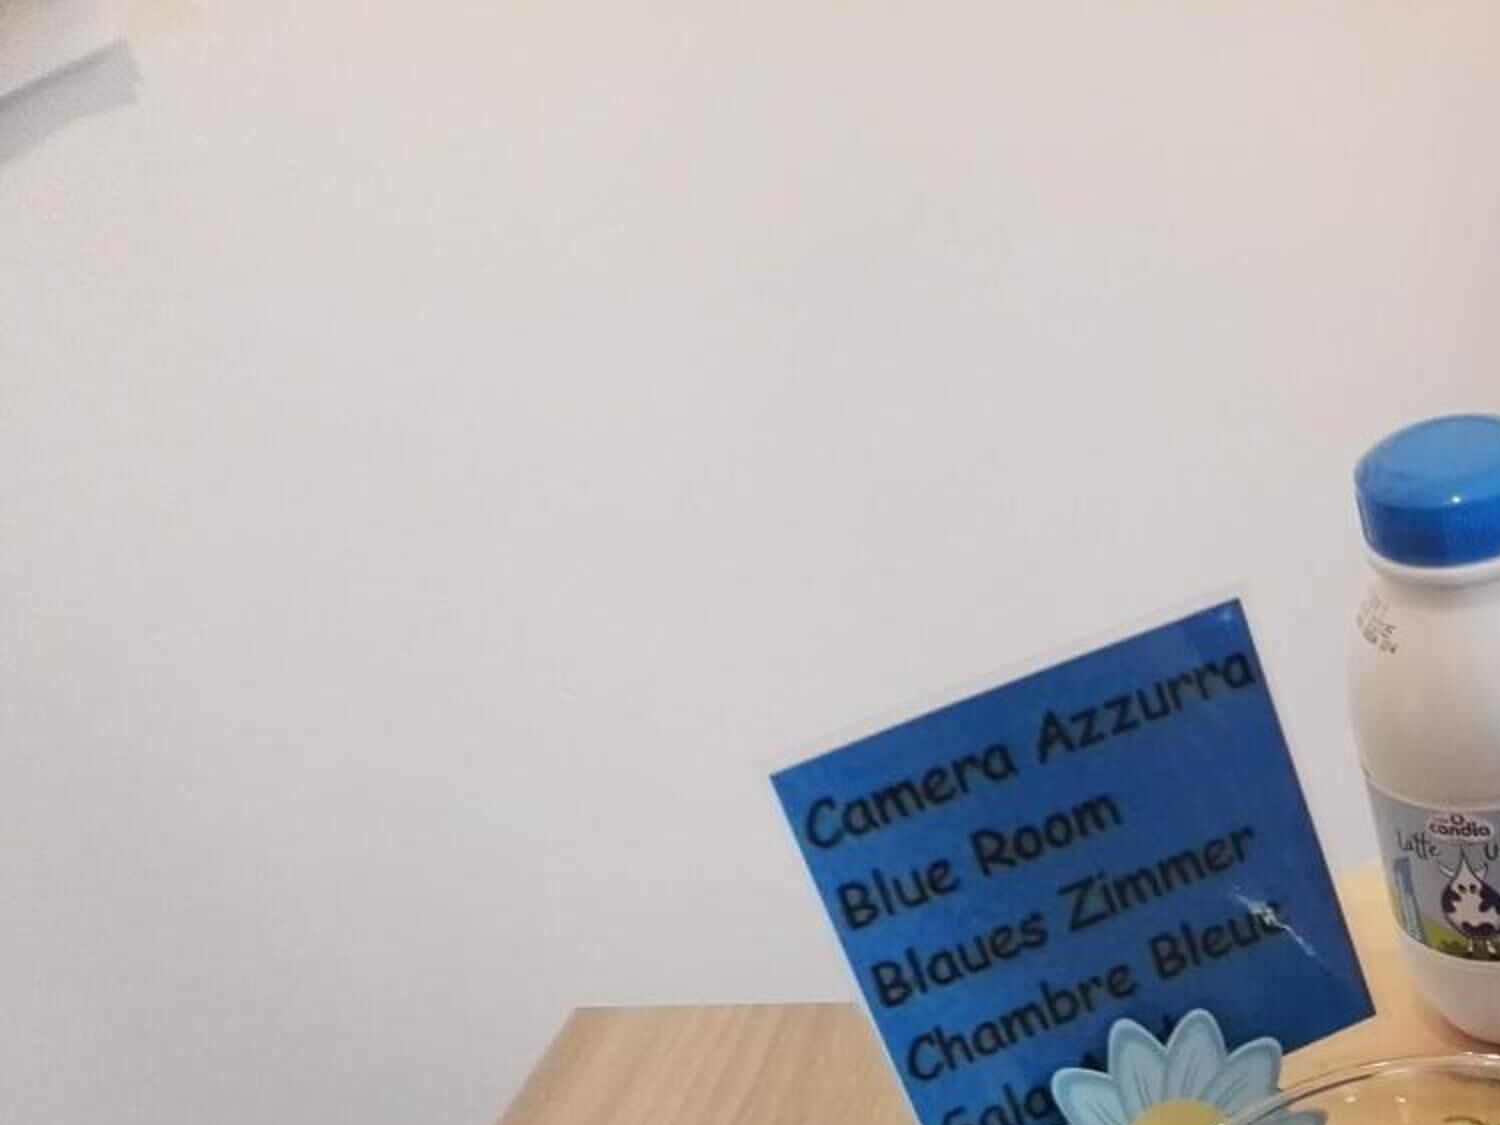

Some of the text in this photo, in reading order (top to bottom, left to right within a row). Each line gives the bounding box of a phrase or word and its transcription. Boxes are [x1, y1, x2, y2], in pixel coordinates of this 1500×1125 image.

[805, 649, 1258, 850] Camera Azzurra
[838, 793, 1122, 931] Blue Room
[1429, 821, 1492, 838] candia
[870, 826, 1256, 1009] Blaues Zimmer
[907, 965, 1138, 1082] Chambre
